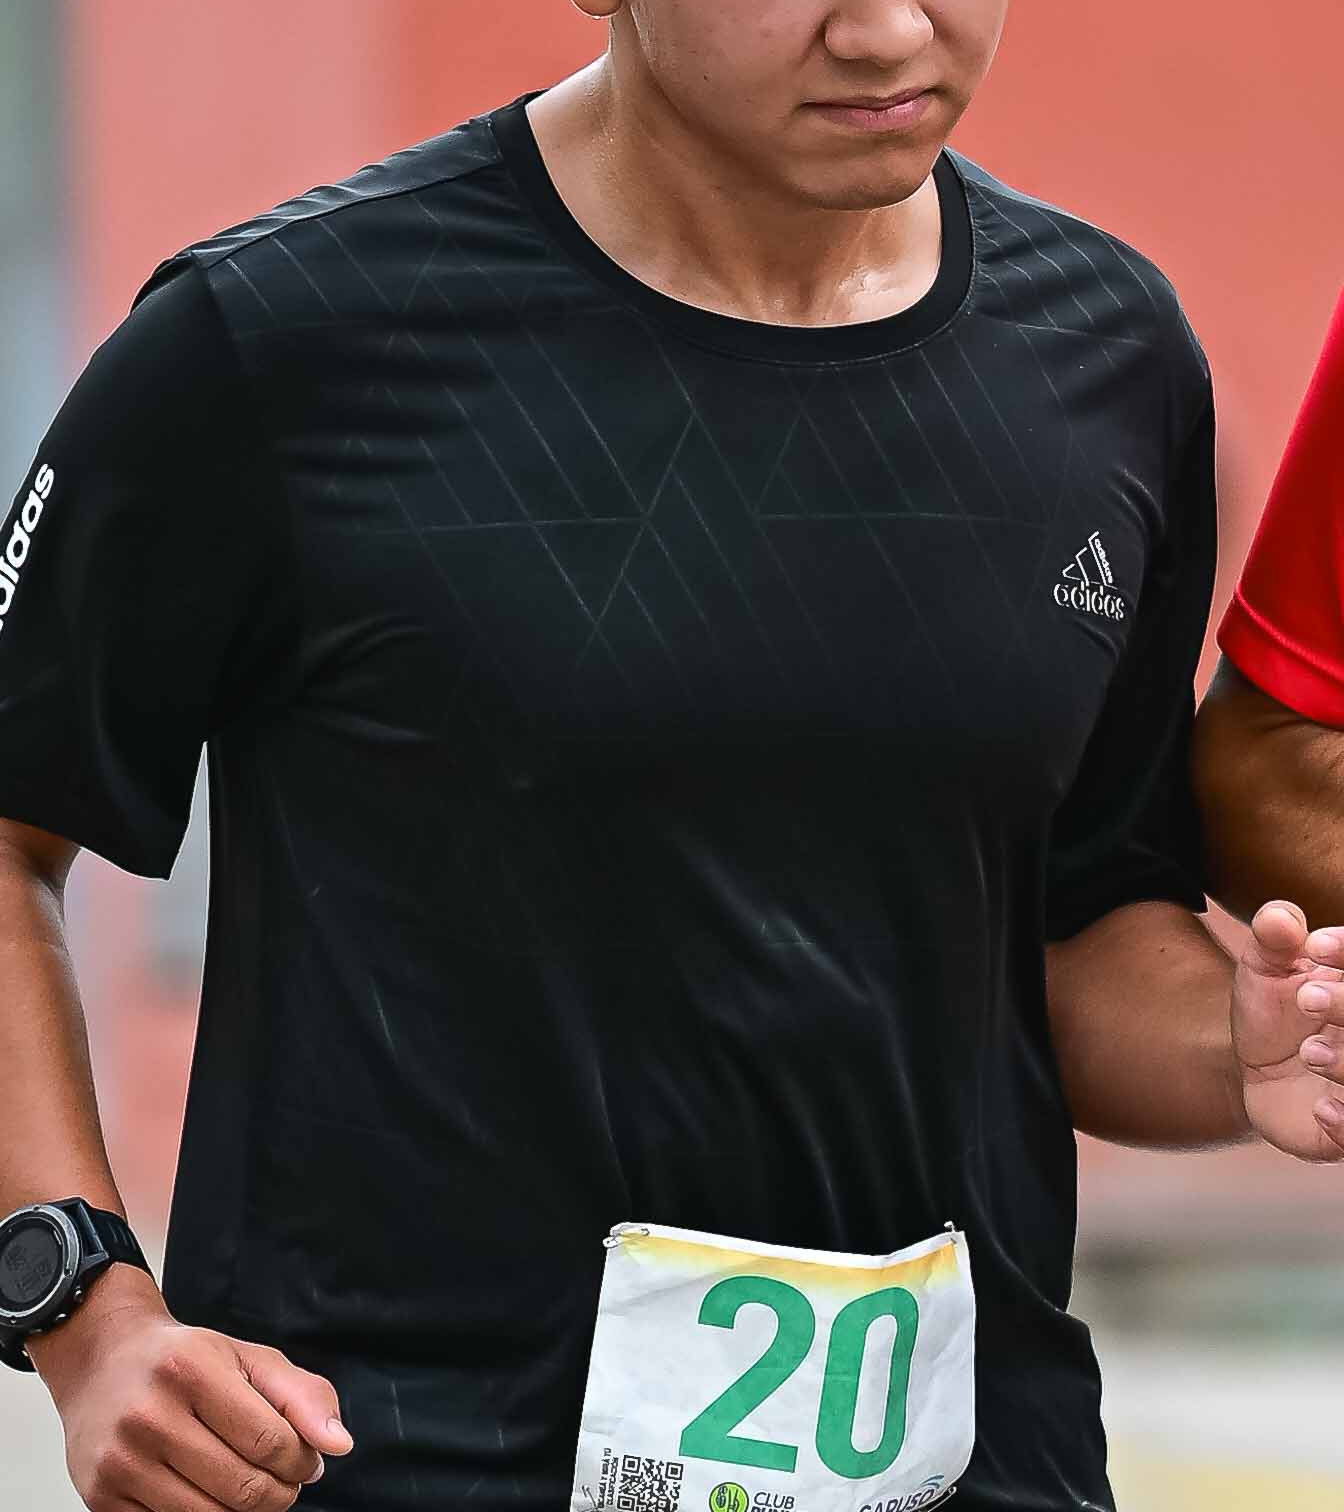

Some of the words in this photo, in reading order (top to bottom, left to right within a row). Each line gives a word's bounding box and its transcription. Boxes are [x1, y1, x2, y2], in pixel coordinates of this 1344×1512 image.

[1053, 580, 1125, 622] adidas
[678, 1274, 920, 1480] 20
[753, 1491, 796, 1510] CLUB
